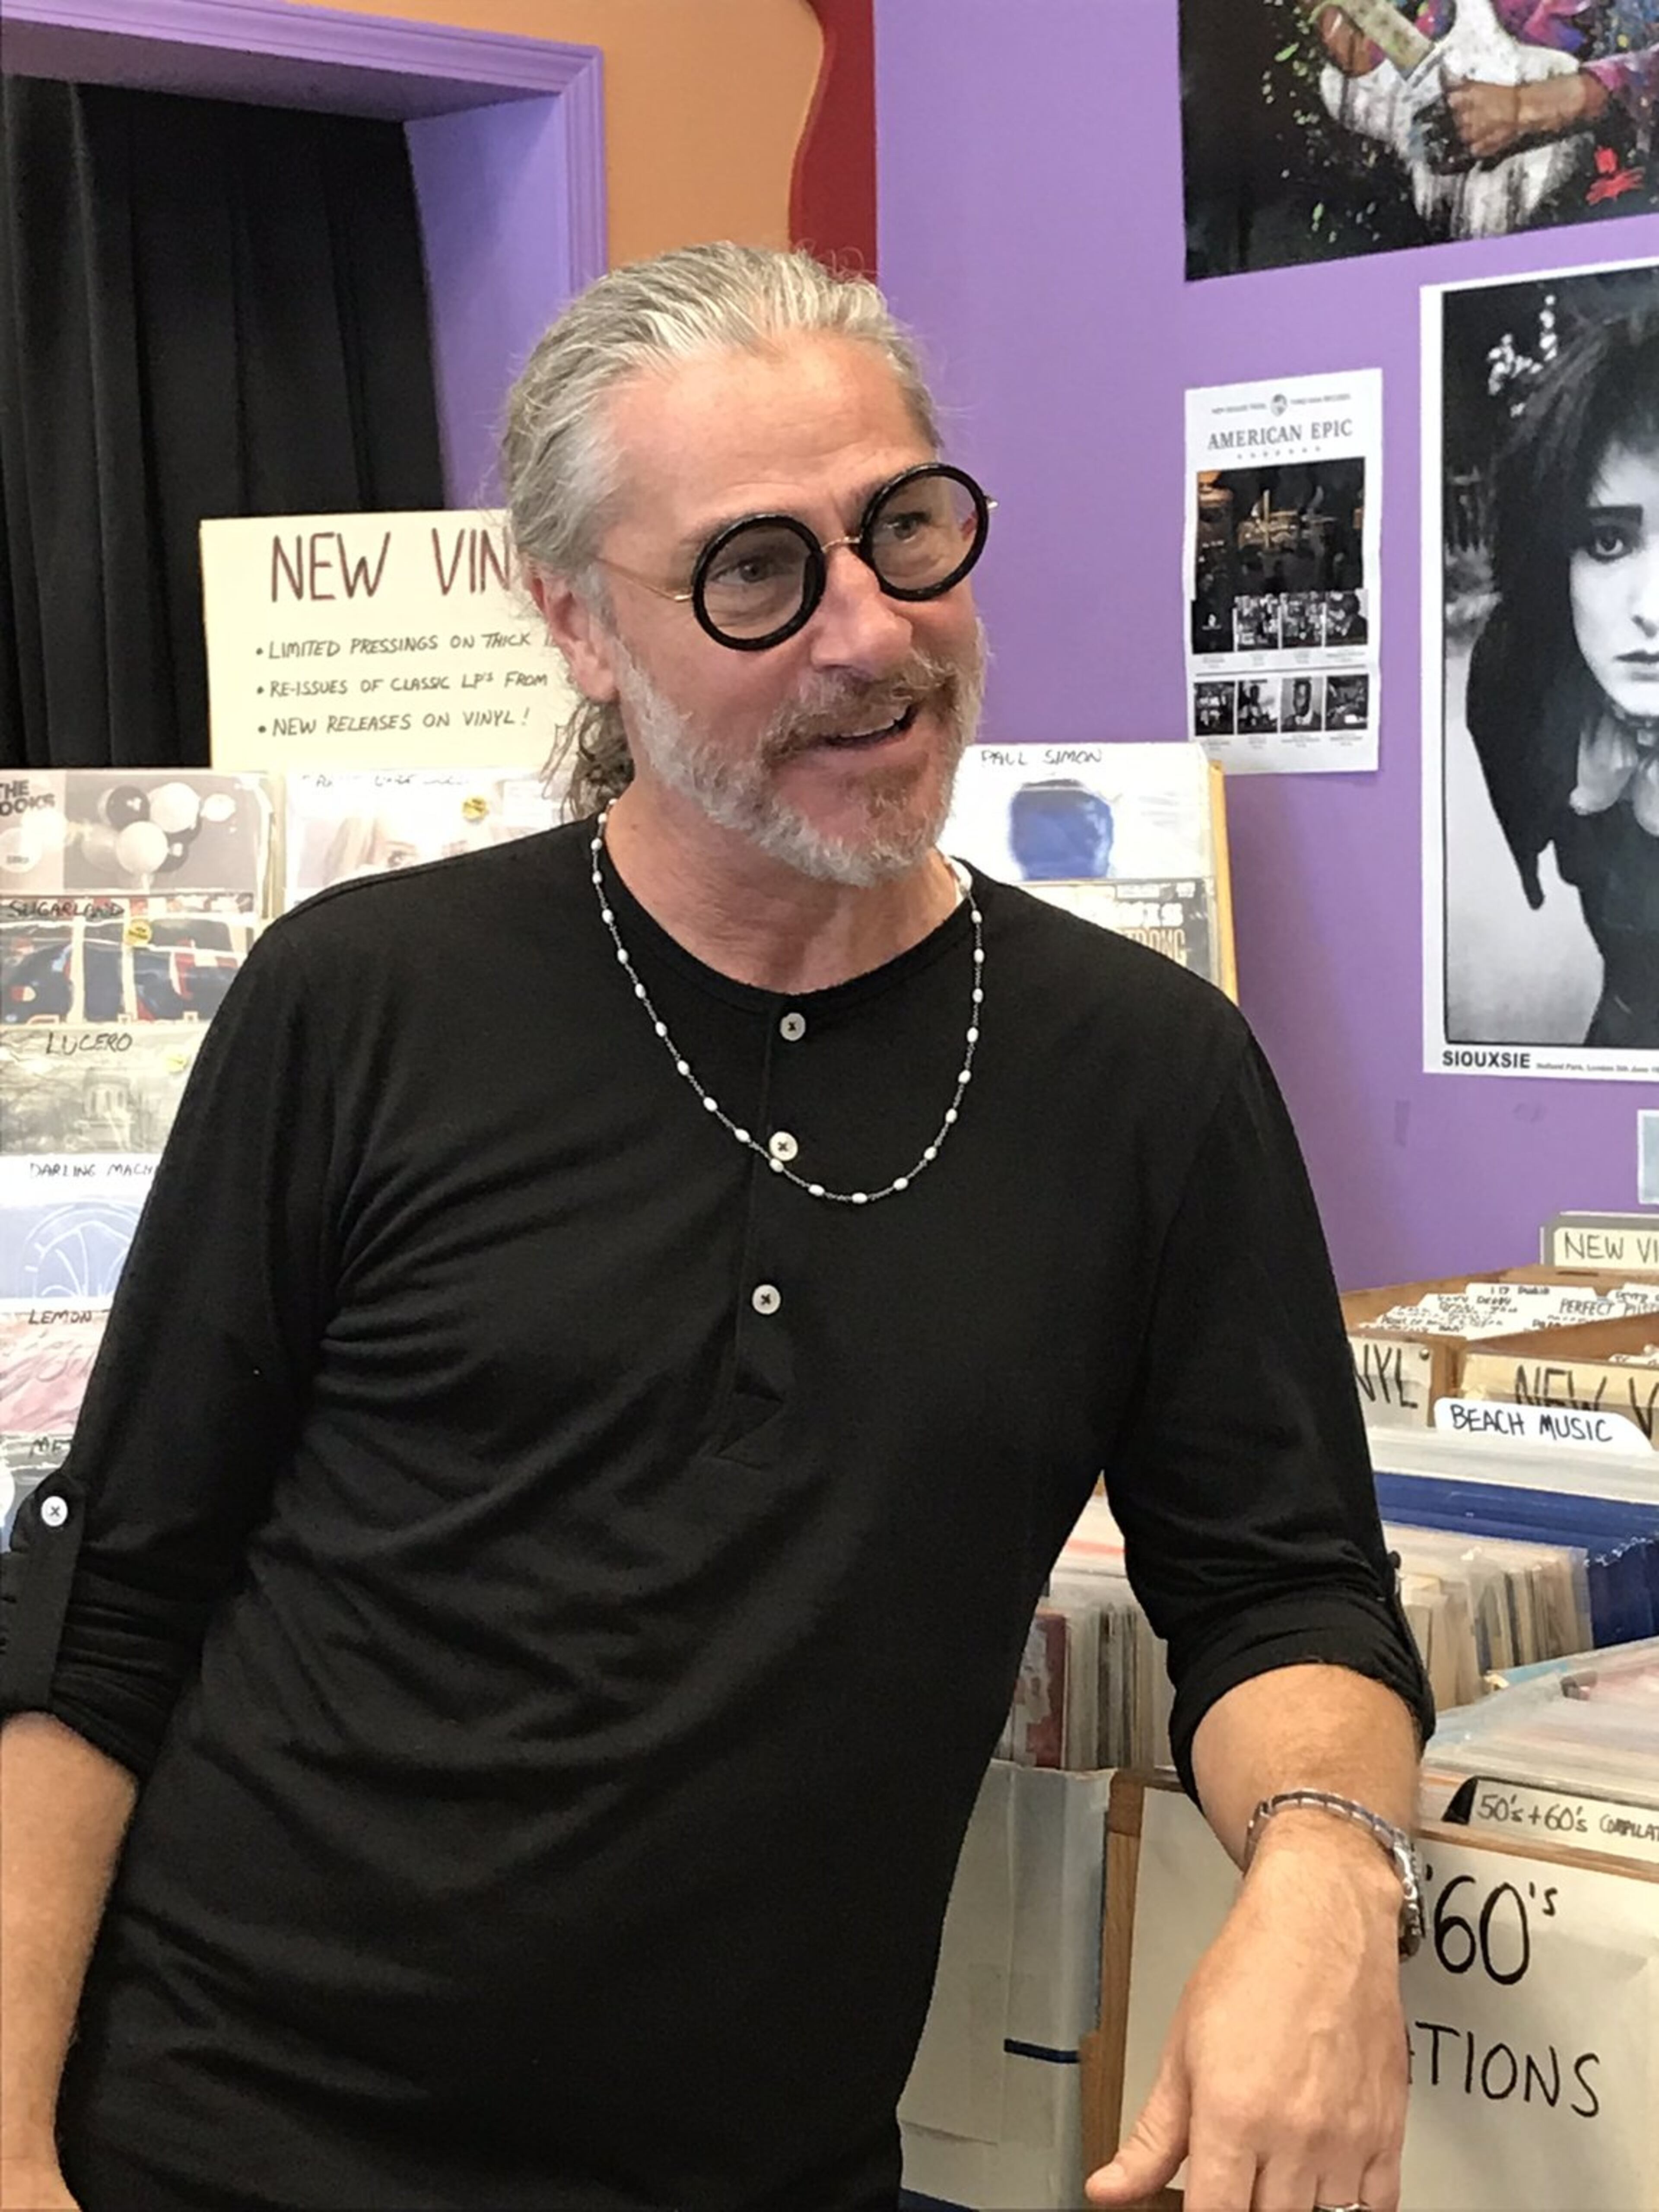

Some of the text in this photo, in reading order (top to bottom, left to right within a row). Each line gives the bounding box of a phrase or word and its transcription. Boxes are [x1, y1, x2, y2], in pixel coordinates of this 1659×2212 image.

[1208, 419, 1353, 450] AMERICAN EPIC
[271, 531, 391, 602] NEW
[268, 637, 340, 659] LIMITED
[350, 634, 439, 655] PRESSINGS
[450, 635, 475, 649] ON
[481, 632, 531, 648] THICK
[270, 680, 348, 698] RE-ISSUES
[360, 678, 384, 693] OF
[391, 675, 450, 693] CLASSIC
[504, 671, 547, 688] FROM
[272, 717, 317, 737] NEW
[326, 712, 411, 733] RELEASES
[423, 711, 450, 728] ON
[1042, 748, 1103, 765] SIMON
[45, 1032, 133, 1055] LUCERO
[1442, 1050, 1531, 1068] SIOUXSIE
[30, 1163, 95, 1177] DARLING
[1564, 1231, 1624, 1259] NEW
[29, 1309, 92, 1325] LEMON
[1450, 1404, 1613, 1443] BEACH MUSIC
